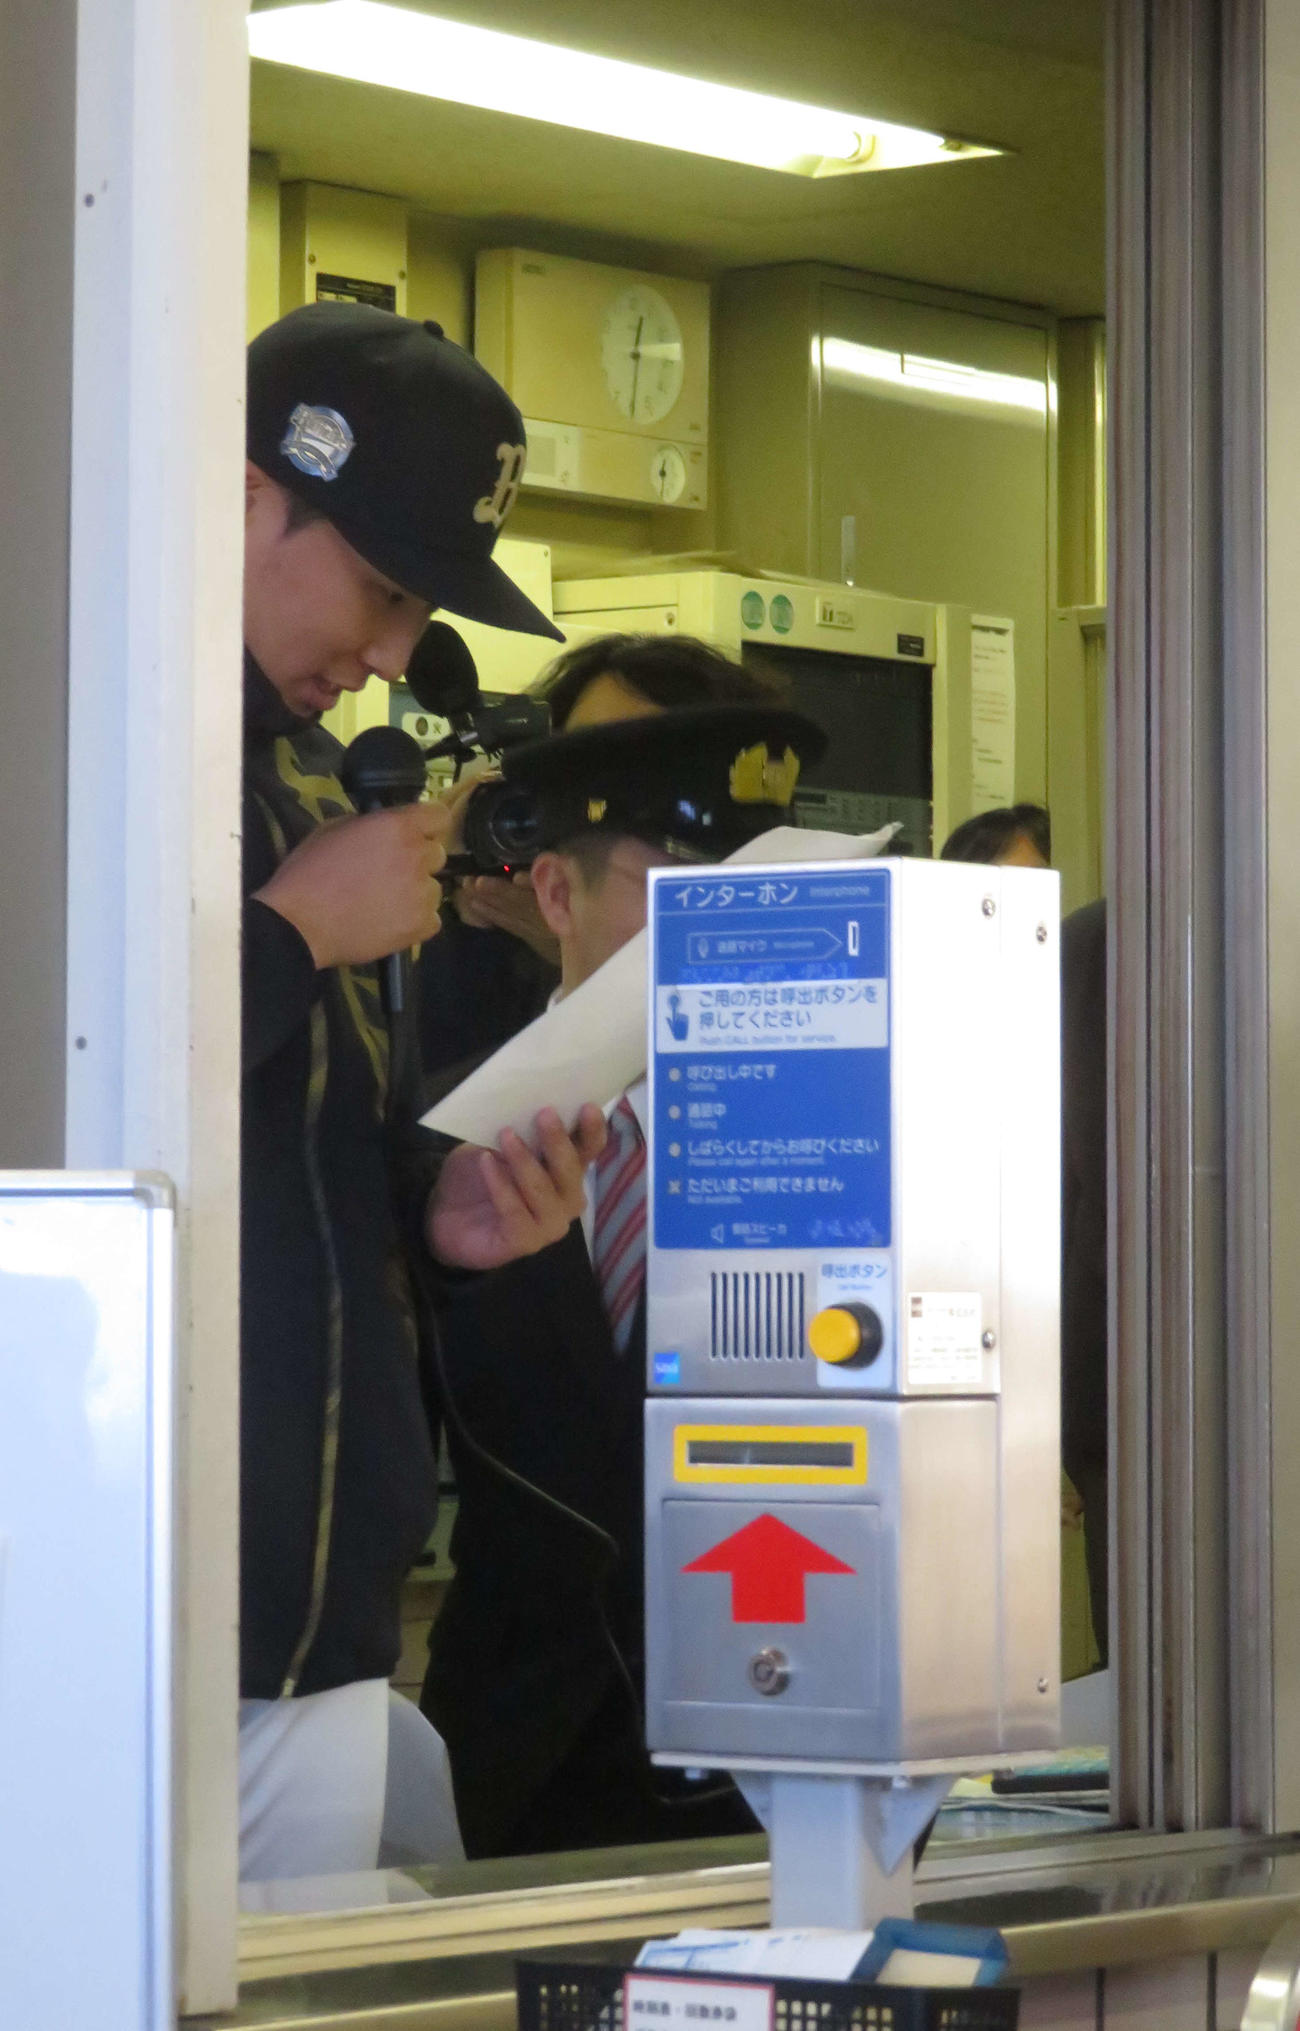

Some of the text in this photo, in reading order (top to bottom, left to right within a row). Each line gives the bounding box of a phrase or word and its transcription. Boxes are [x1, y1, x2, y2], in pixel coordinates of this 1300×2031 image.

[675, 882, 798, 908] インターホン
[700, 985, 878, 1008] ご用の方は呼出ボタンを
[699, 1010, 812, 1030] 押してください
[821, 1263, 888, 1279] 呼出ボタン
